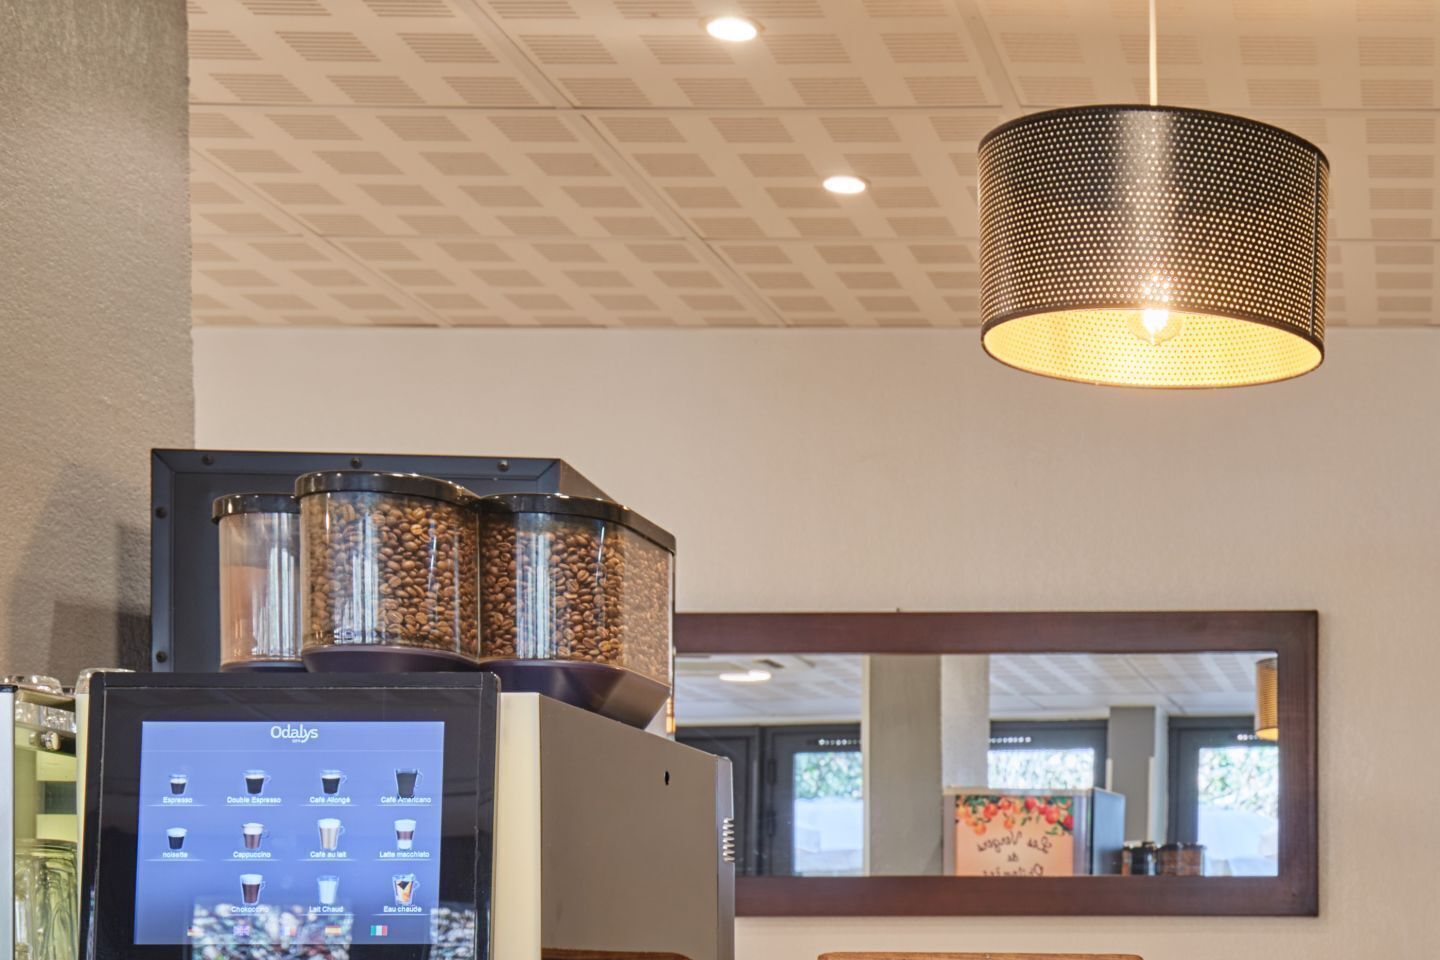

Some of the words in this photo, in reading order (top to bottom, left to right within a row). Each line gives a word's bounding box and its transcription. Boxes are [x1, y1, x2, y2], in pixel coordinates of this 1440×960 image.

[270, 724, 319, 743] Odalys
[162, 796, 193, 806] Espresso
[226, 796, 249, 804] Double
[250, 796, 282, 806] Espresso
[309, 796, 327, 804] Café
[380, 796, 398, 804] Café
[398, 796, 432, 804] Americano
[162, 850, 189, 859] noisette
[233, 850, 272, 860] Cappuccino
[310, 850, 326, 859] Café
[337, 850, 347, 859] lait
[379, 850, 396, 859] Latte
[396, 850, 430, 859] macchiato
[309, 905, 322, 914] Lait
[323, 905, 344, 914] Chaud
[383, 905, 397, 914] Eau
[397, 905, 422, 914] chaude
